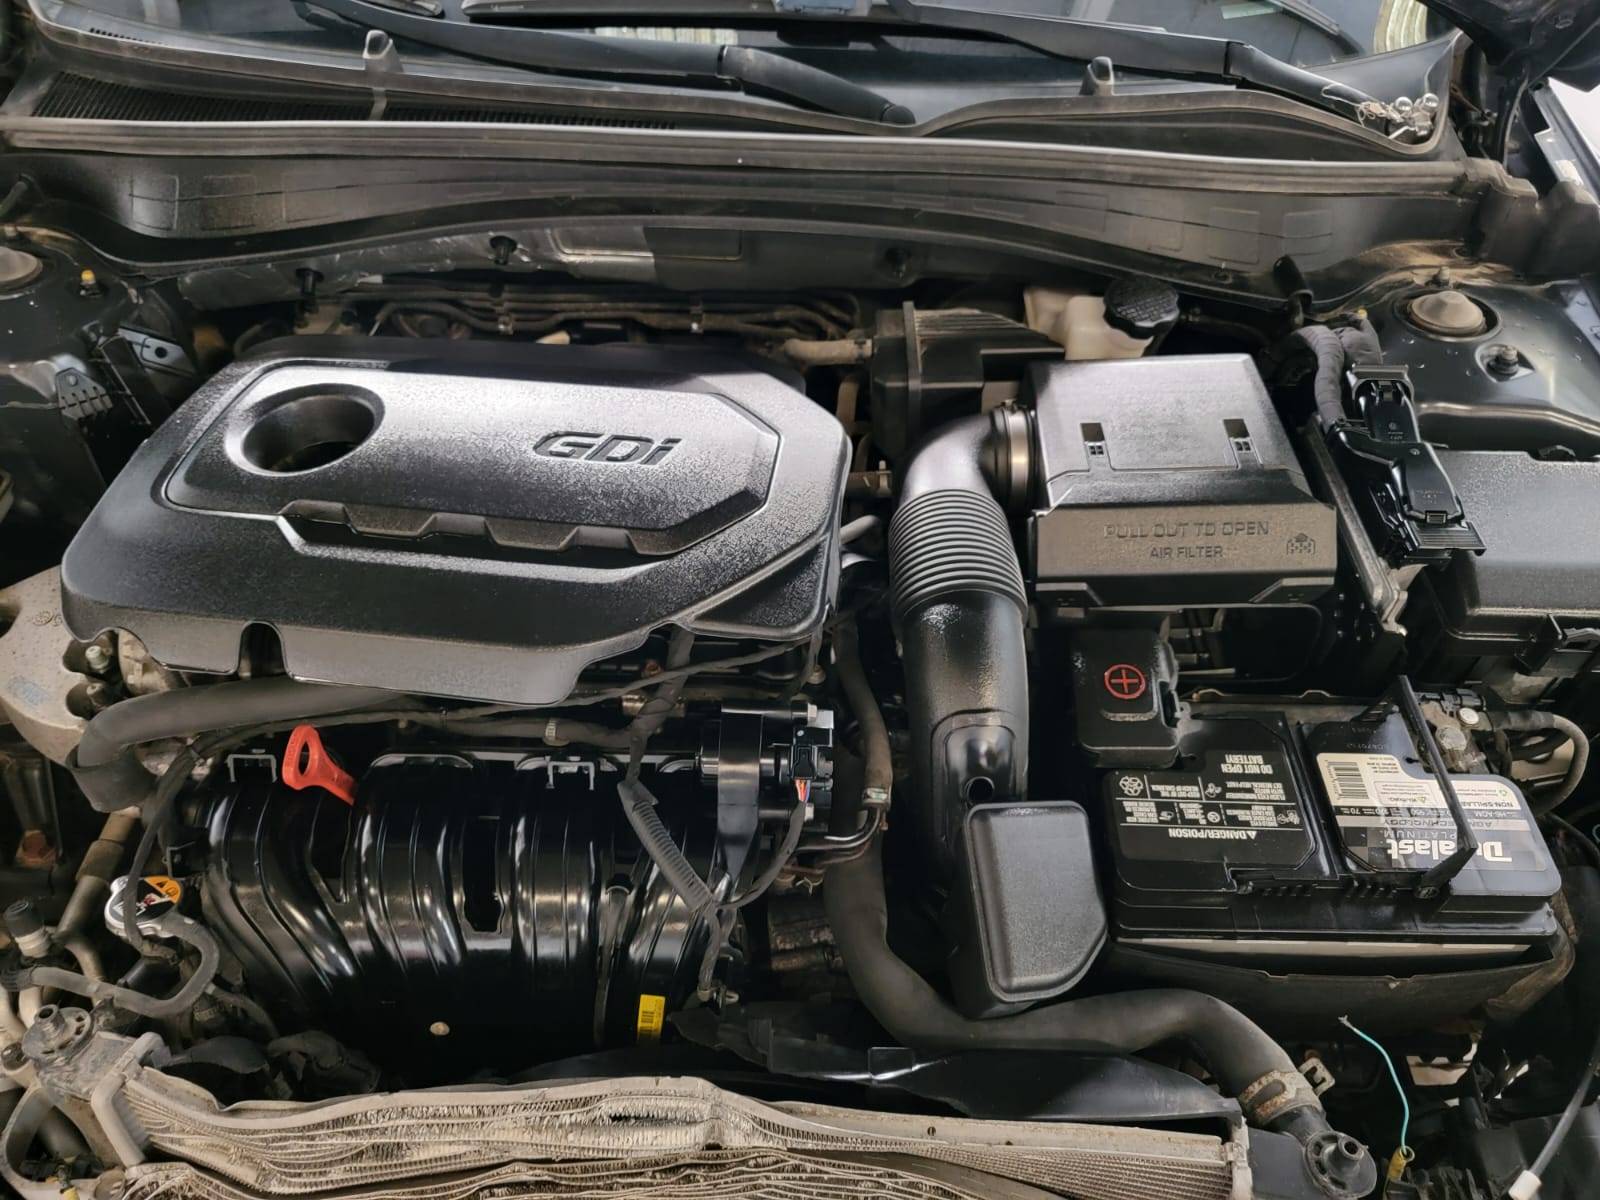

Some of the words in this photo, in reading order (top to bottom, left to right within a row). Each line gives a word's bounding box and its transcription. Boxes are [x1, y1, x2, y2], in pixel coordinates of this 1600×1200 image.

[532, 431, 682, 465] GDi
[1104, 525, 1148, 539] PULL
[1153, 523, 1189, 538] OUT
[1194, 522, 1217, 536] TO
[1222, 521, 1269, 536] OPEN
[1150, 546, 1173, 559] AIR
[1177, 546, 1224, 558] FILTER
[1220, 763, 1243, 773] OPEN
[1243, 764, 1260, 774] NOT
[1260, 764, 1273, 774] DO
[1383, 818, 1455, 827] ECHNOLOGY
[1168, 828, 1247, 839] DANGER/POISON
